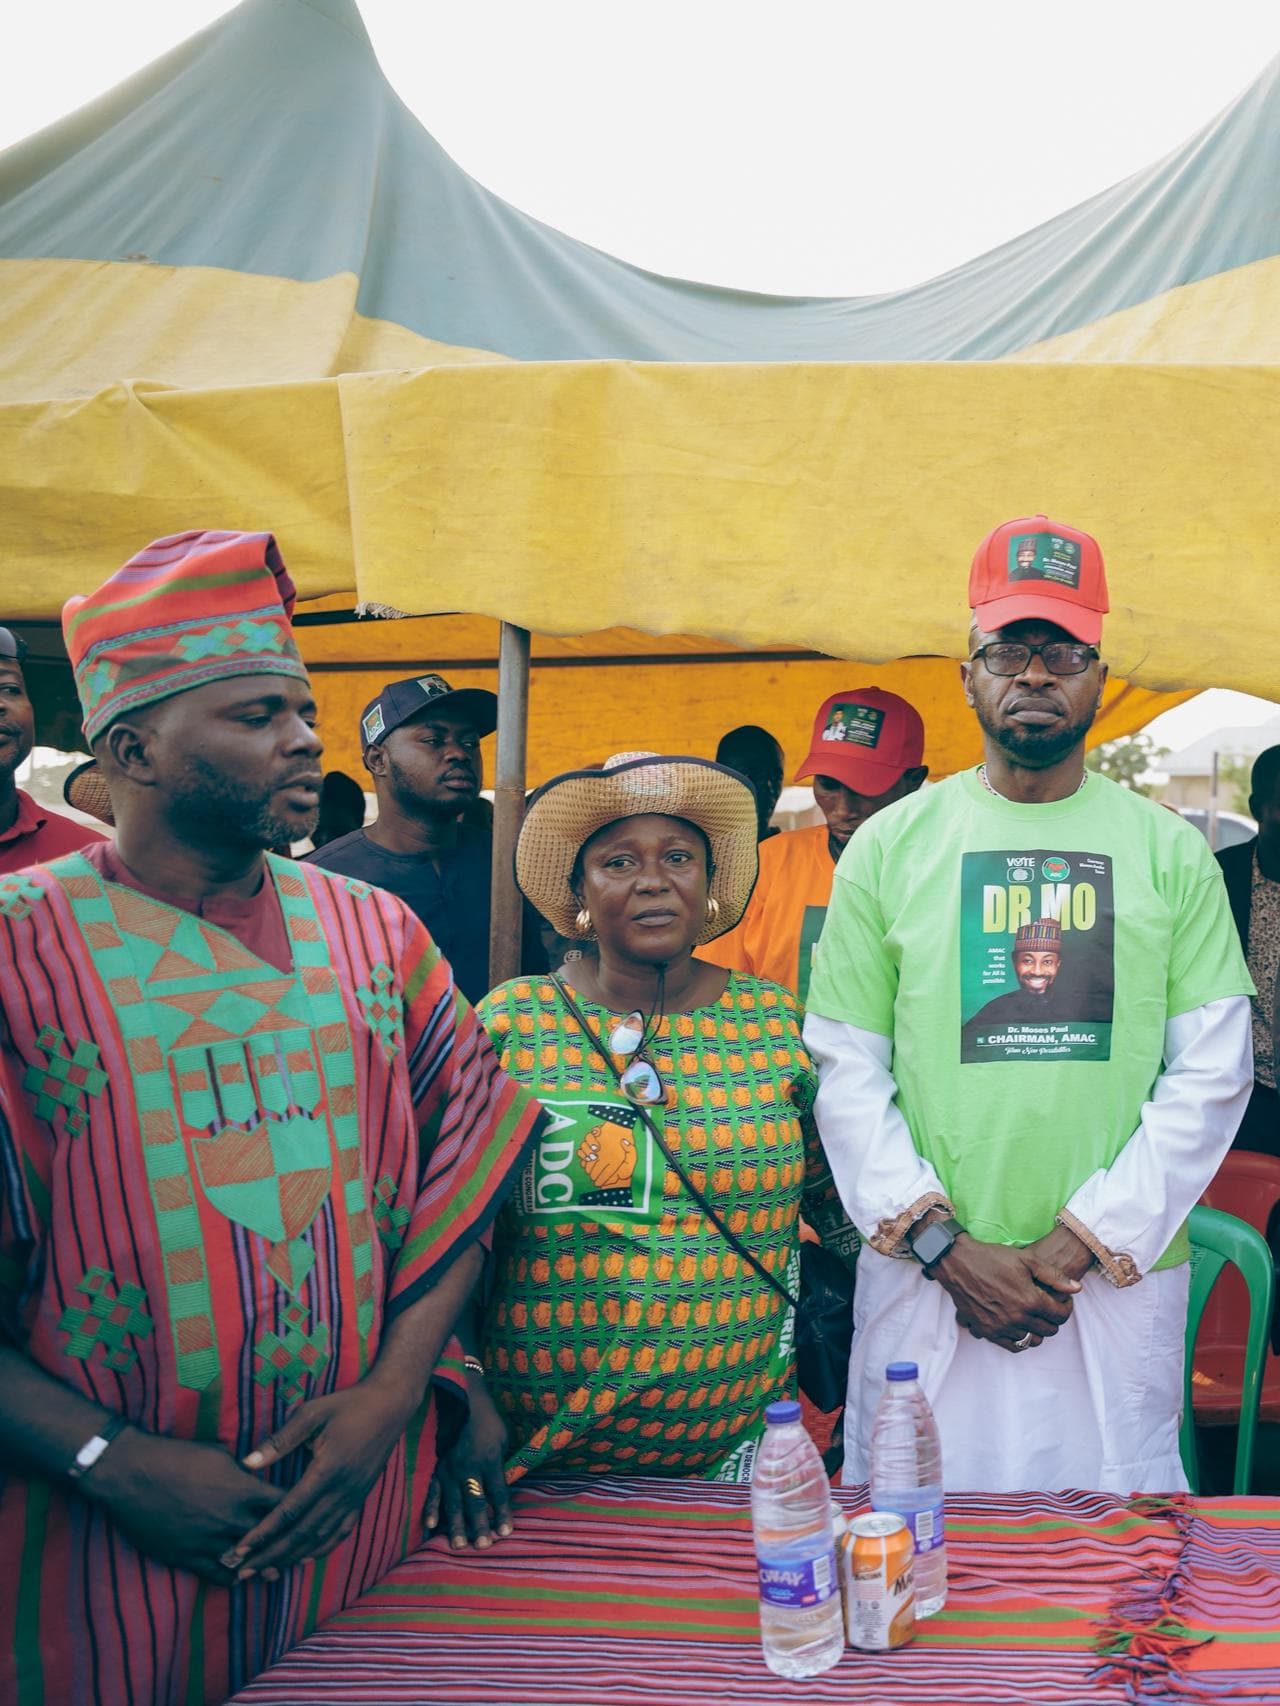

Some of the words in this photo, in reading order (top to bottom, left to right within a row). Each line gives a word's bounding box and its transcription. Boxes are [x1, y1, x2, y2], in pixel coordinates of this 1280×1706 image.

[1006, 856, 1036, 867] VOTE
[982, 884, 1032, 933] DR
[1041, 882, 1096, 931] MO
[987, 1034, 1059, 1044] CHAIRMAN,
[1061, 1034, 1096, 1042] AMAC
[537, 1106, 578, 1204] ADC
[760, 1568, 804, 1587] CWAY
